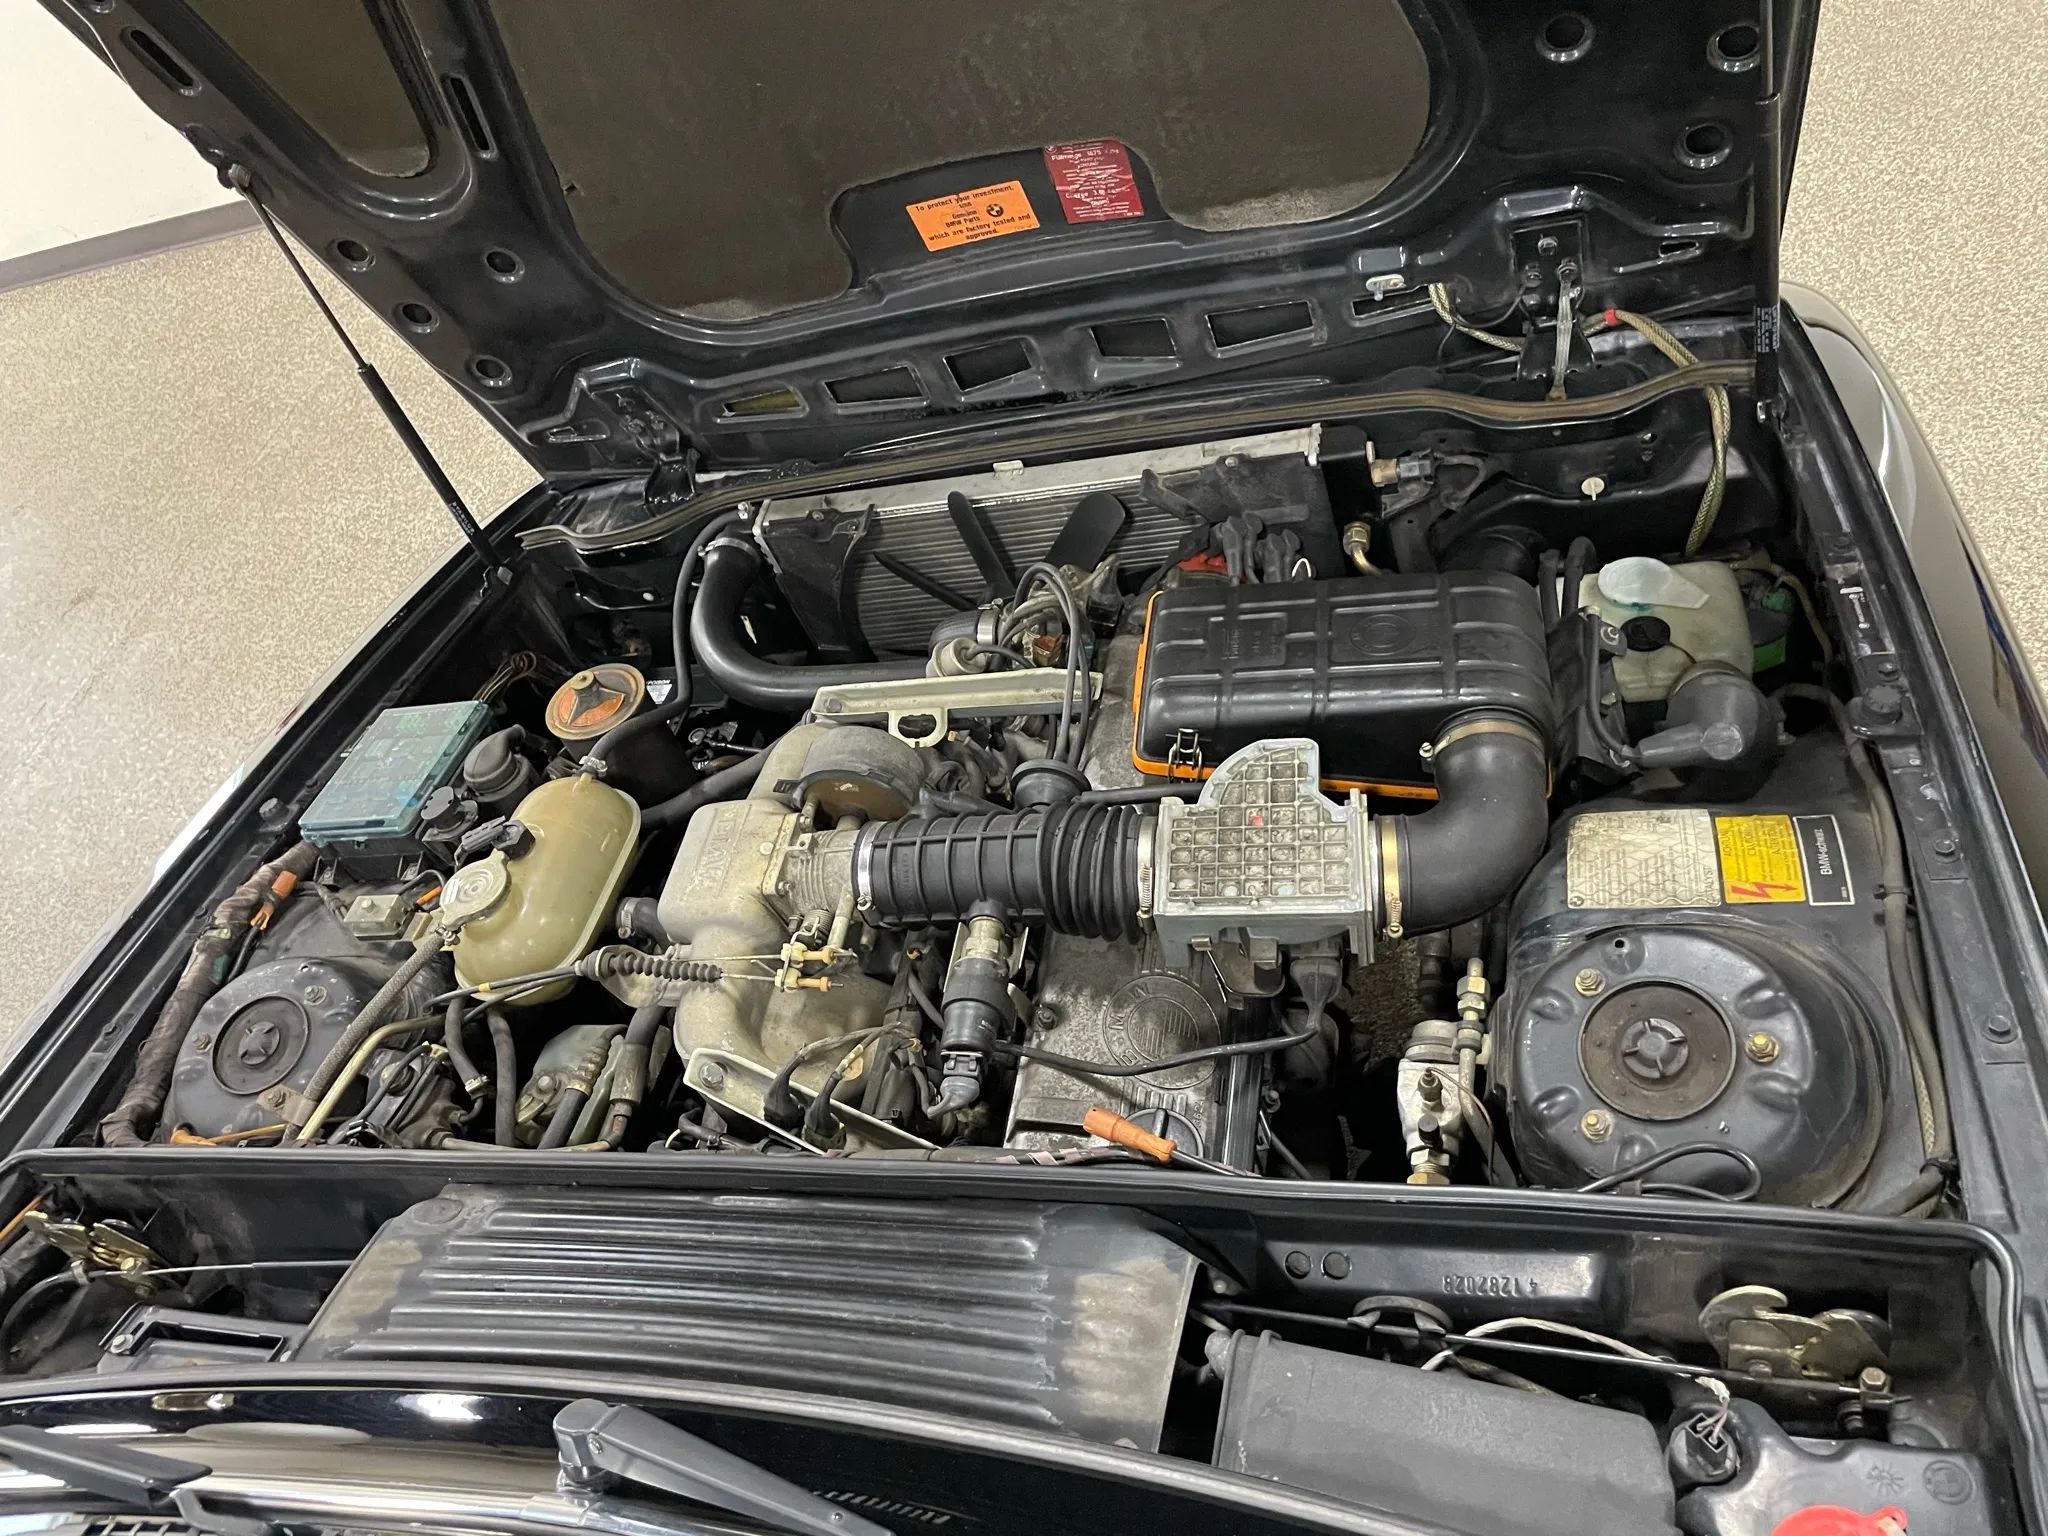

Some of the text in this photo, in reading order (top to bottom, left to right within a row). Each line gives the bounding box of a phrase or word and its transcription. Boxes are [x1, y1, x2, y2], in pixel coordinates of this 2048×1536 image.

[927, 198, 952, 210] protect
[955, 195, 970, 204] your
[972, 185, 1014, 199] investment.
[928, 231, 950, 241] which
[966, 223, 991, 233] factory
[992, 216, 1015, 226] tested
[1018, 213, 1031, 221] and
[945, 215, 981, 228] BMW Parts
[965, 230, 999, 241] approved.
